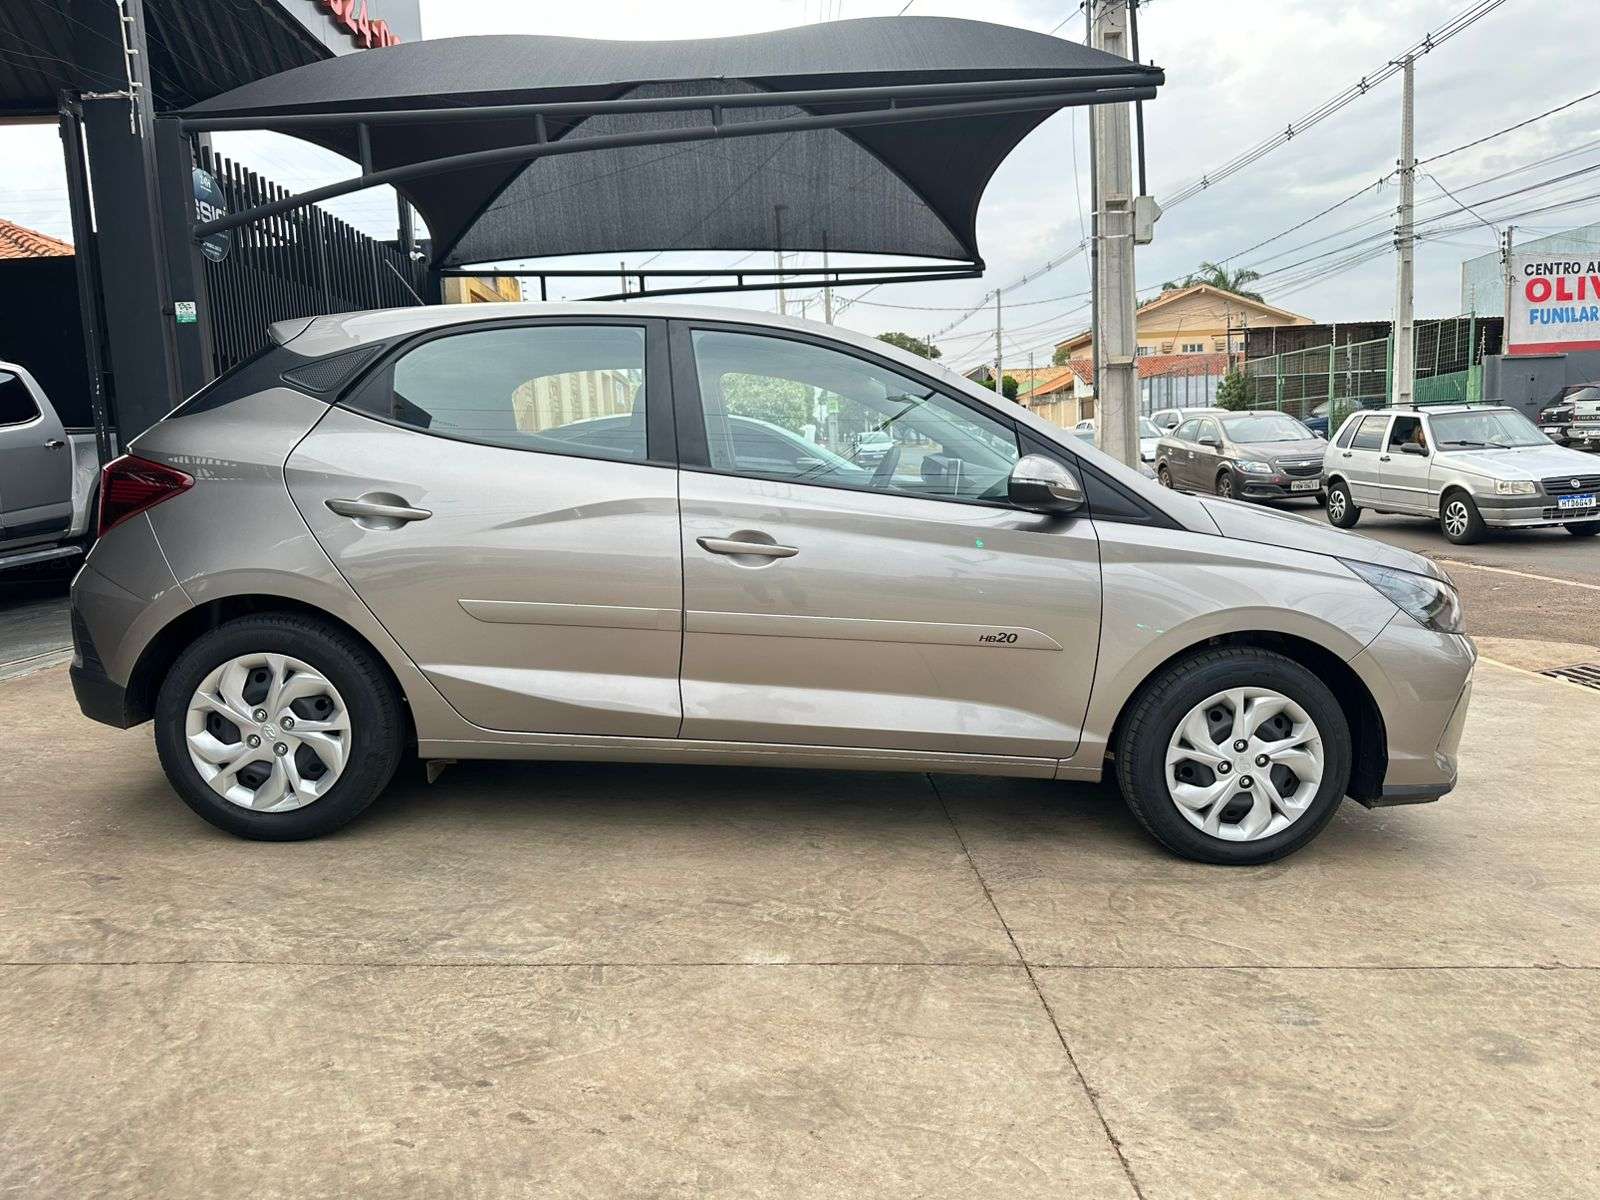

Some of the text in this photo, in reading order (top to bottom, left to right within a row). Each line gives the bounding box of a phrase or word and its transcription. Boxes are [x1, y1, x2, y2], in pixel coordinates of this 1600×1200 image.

[1524, 261, 1600, 276] CENTRO A
[979, 632, 1018, 644] HB20
